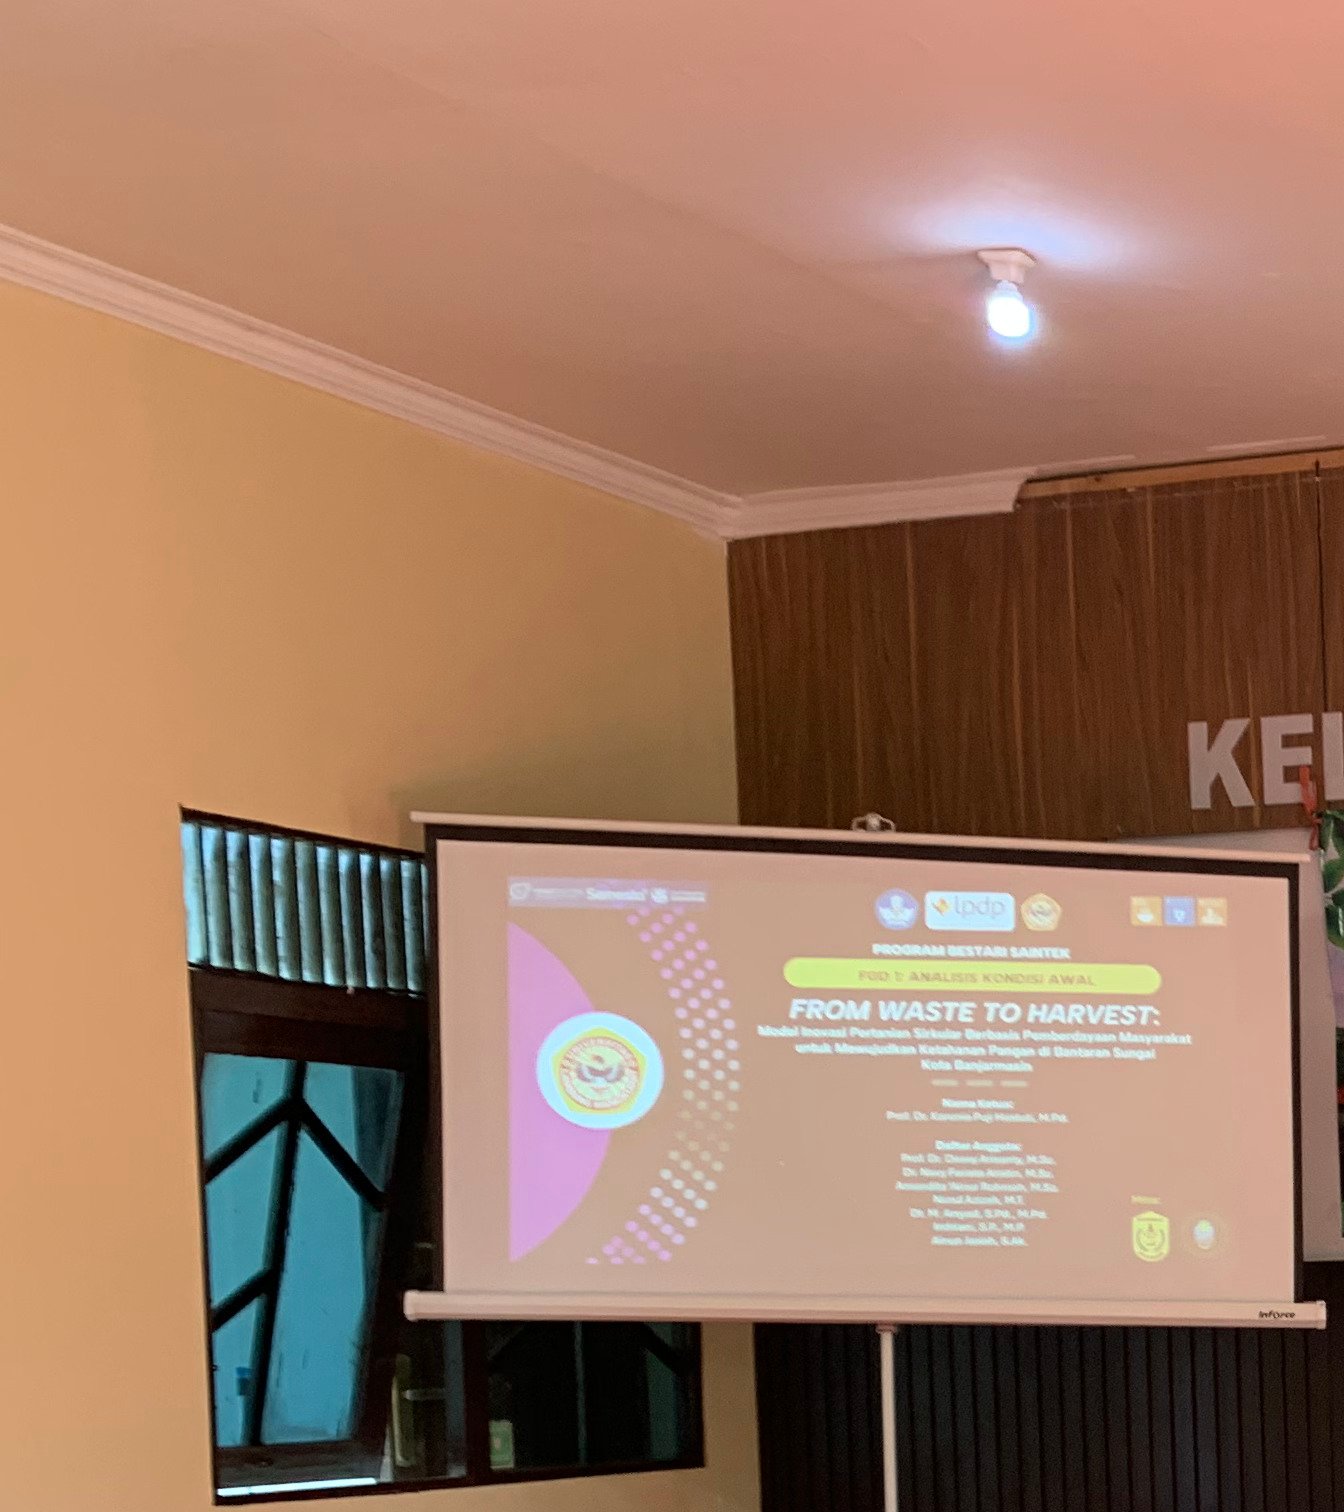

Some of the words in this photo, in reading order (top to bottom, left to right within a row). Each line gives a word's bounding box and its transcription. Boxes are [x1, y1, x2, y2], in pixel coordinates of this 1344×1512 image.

[955, 896, 1006, 918] lpdp
[982, 973, 1043, 984] KONDISI
[1048, 974, 1097, 986] AWAL
[789, 999, 871, 1021] FROM
[878, 1000, 977, 1023] WASTE
[983, 1002, 1023, 1024] TO
[1026, 1003, 1161, 1027] HARVEST:
